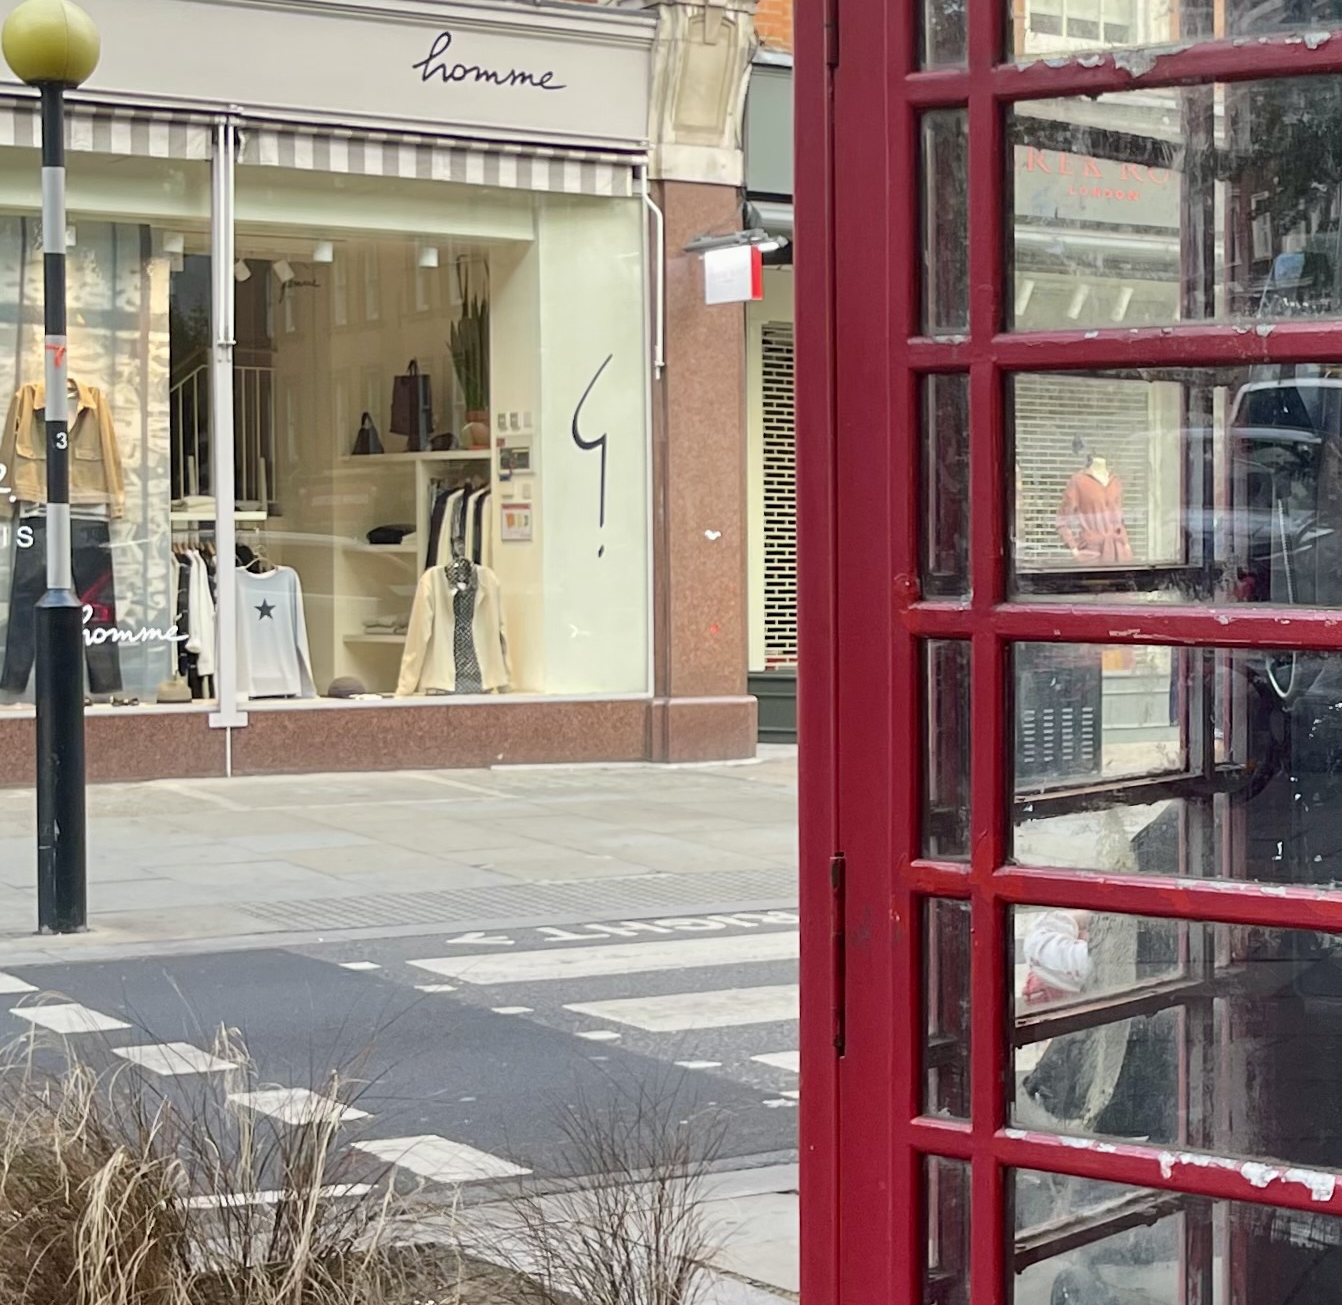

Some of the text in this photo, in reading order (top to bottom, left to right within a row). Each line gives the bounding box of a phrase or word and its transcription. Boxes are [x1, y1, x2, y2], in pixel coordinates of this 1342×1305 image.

[412, 31, 567, 89] homme
[1068, 185, 1140, 201] LONDON
[56, 432, 68, 450] 3
[536, 910, 799, 942] RIGHT
